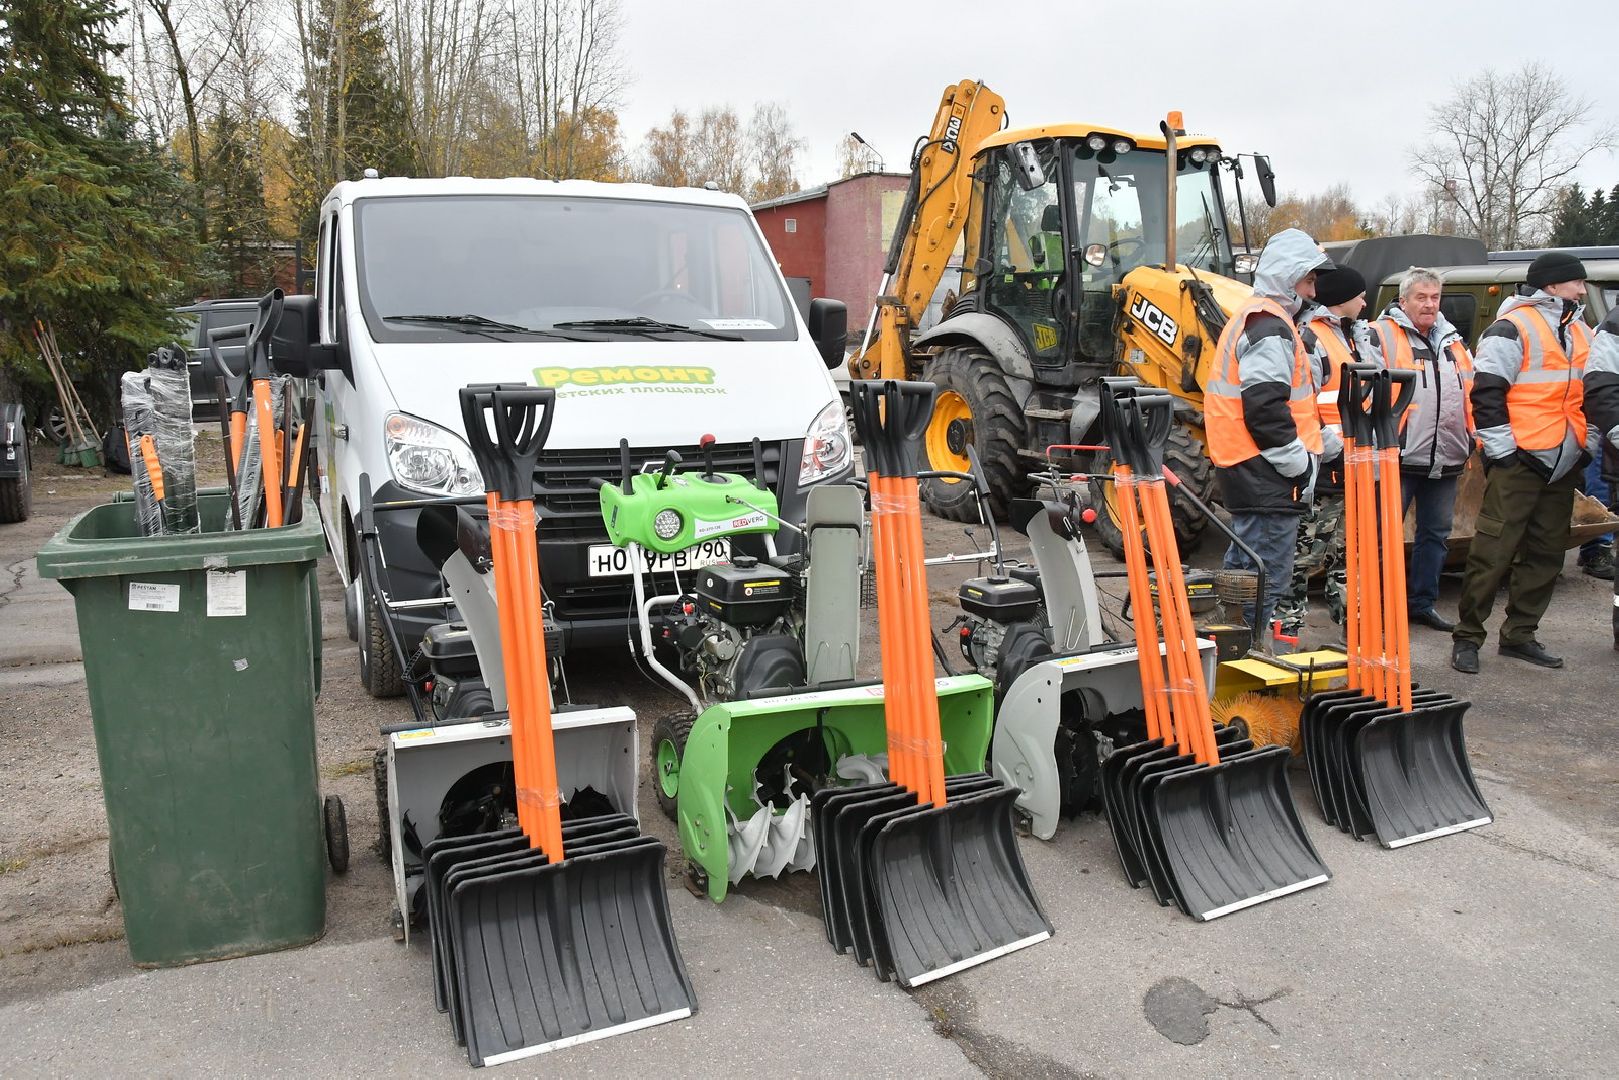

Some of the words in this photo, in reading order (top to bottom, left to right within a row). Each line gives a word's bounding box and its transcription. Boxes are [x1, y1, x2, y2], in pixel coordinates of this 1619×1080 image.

[1132, 299, 1178, 344] JCB
[1036, 325, 1056, 349] JCB
[539, 367, 711, 388] Ремонт
[556, 387, 625, 399] етских
[631, 386, 727, 395] площадок
[732, 515, 764, 528] REDVERG
